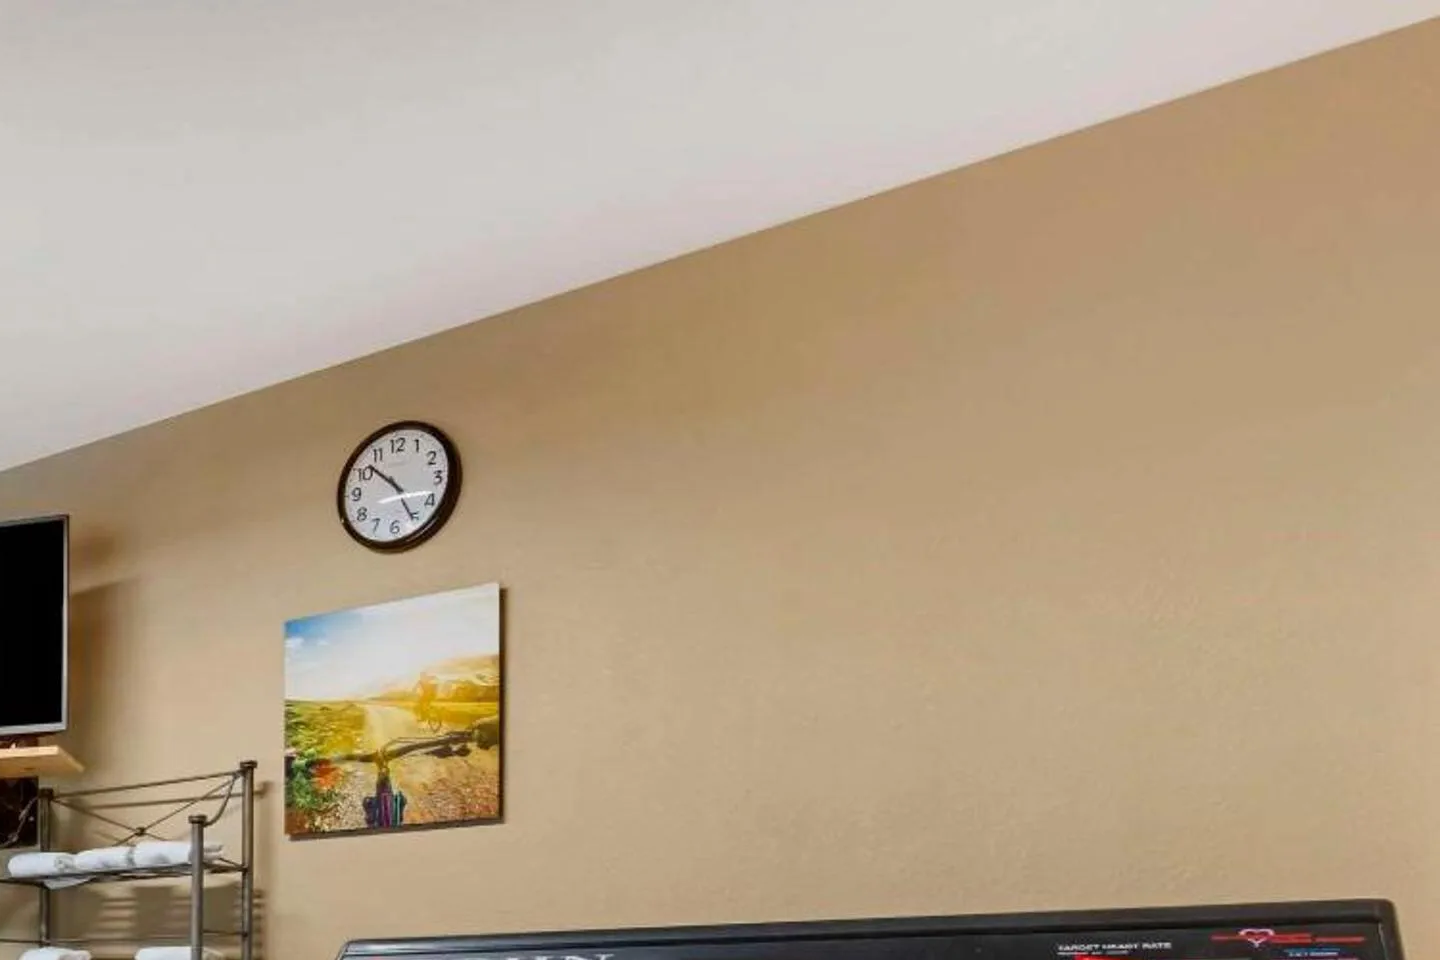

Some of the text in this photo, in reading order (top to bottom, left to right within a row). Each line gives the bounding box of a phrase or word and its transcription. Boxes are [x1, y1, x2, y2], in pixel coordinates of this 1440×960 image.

[390, 437, 406, 453] 12
[414, 439, 420, 452] 1
[373, 448, 383, 462] 11
[426, 451, 437, 465] 2
[353, 466, 374, 481] 10
[433, 470, 442, 485] 3
[351, 487, 362, 501] 9
[424, 492, 435, 506] 4
[356, 507, 368, 521] 8
[372, 518, 380, 533] 7
[389, 520, 400, 534] 6
